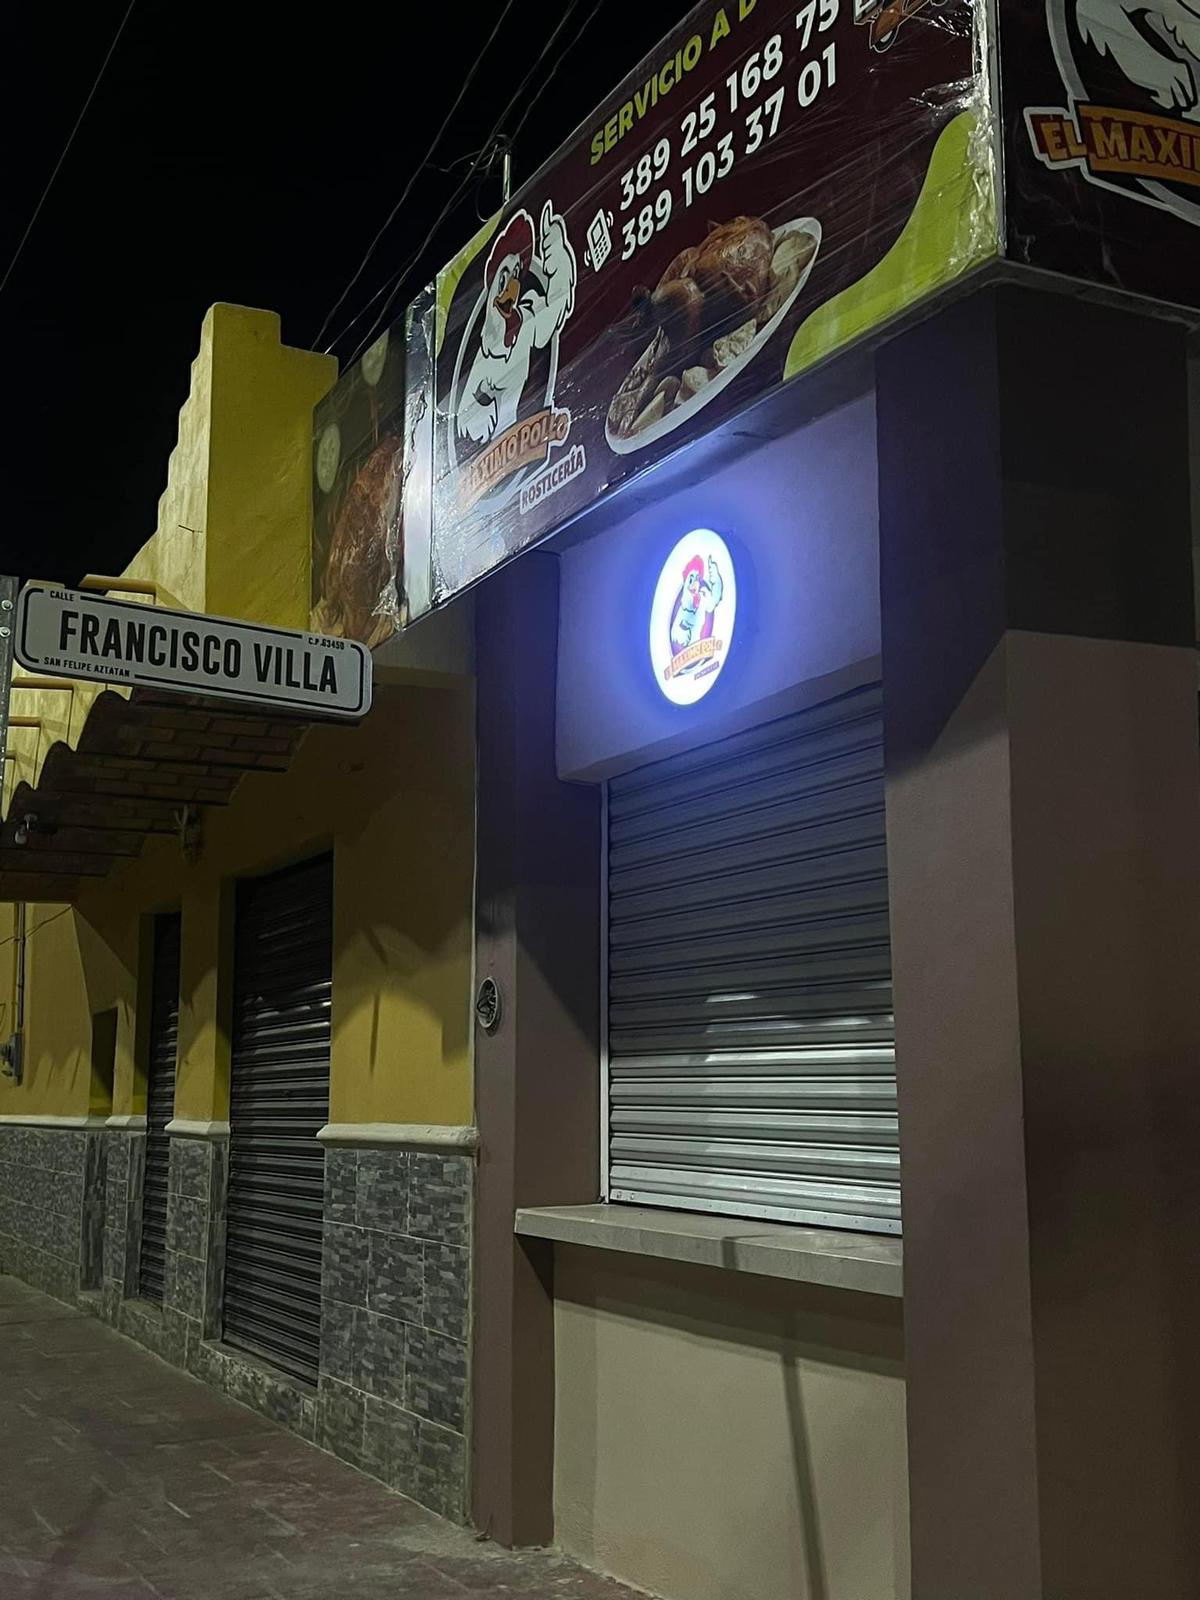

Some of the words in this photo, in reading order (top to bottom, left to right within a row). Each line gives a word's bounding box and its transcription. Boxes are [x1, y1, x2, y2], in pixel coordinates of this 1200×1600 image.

[590, 35, 702, 165] SERVICIO
[709, 8, 732, 51] A
[620, 138, 670, 211] 389
[680, 92, 716, 158] 25
[726, 34, 784, 113] 168
[796, 0, 839, 52] 75
[621, 189, 673, 261] 389
[682, 132, 735, 208] 103
[745, 87, 785, 155] 37
[798, 42, 836, 108] 01
[1040, 120, 1088, 161] EL
[521, 450, 584, 509] ROSTICERÍA
[50, 590, 75, 602] CALLE
[44, 656, 61, 667] SAN
[63, 660, 92, 672] FELIPE
[94, 664, 131, 677] AZTATAN
[59, 610, 242, 679] FRANCISCO
[253, 643, 339, 694] VILLA
